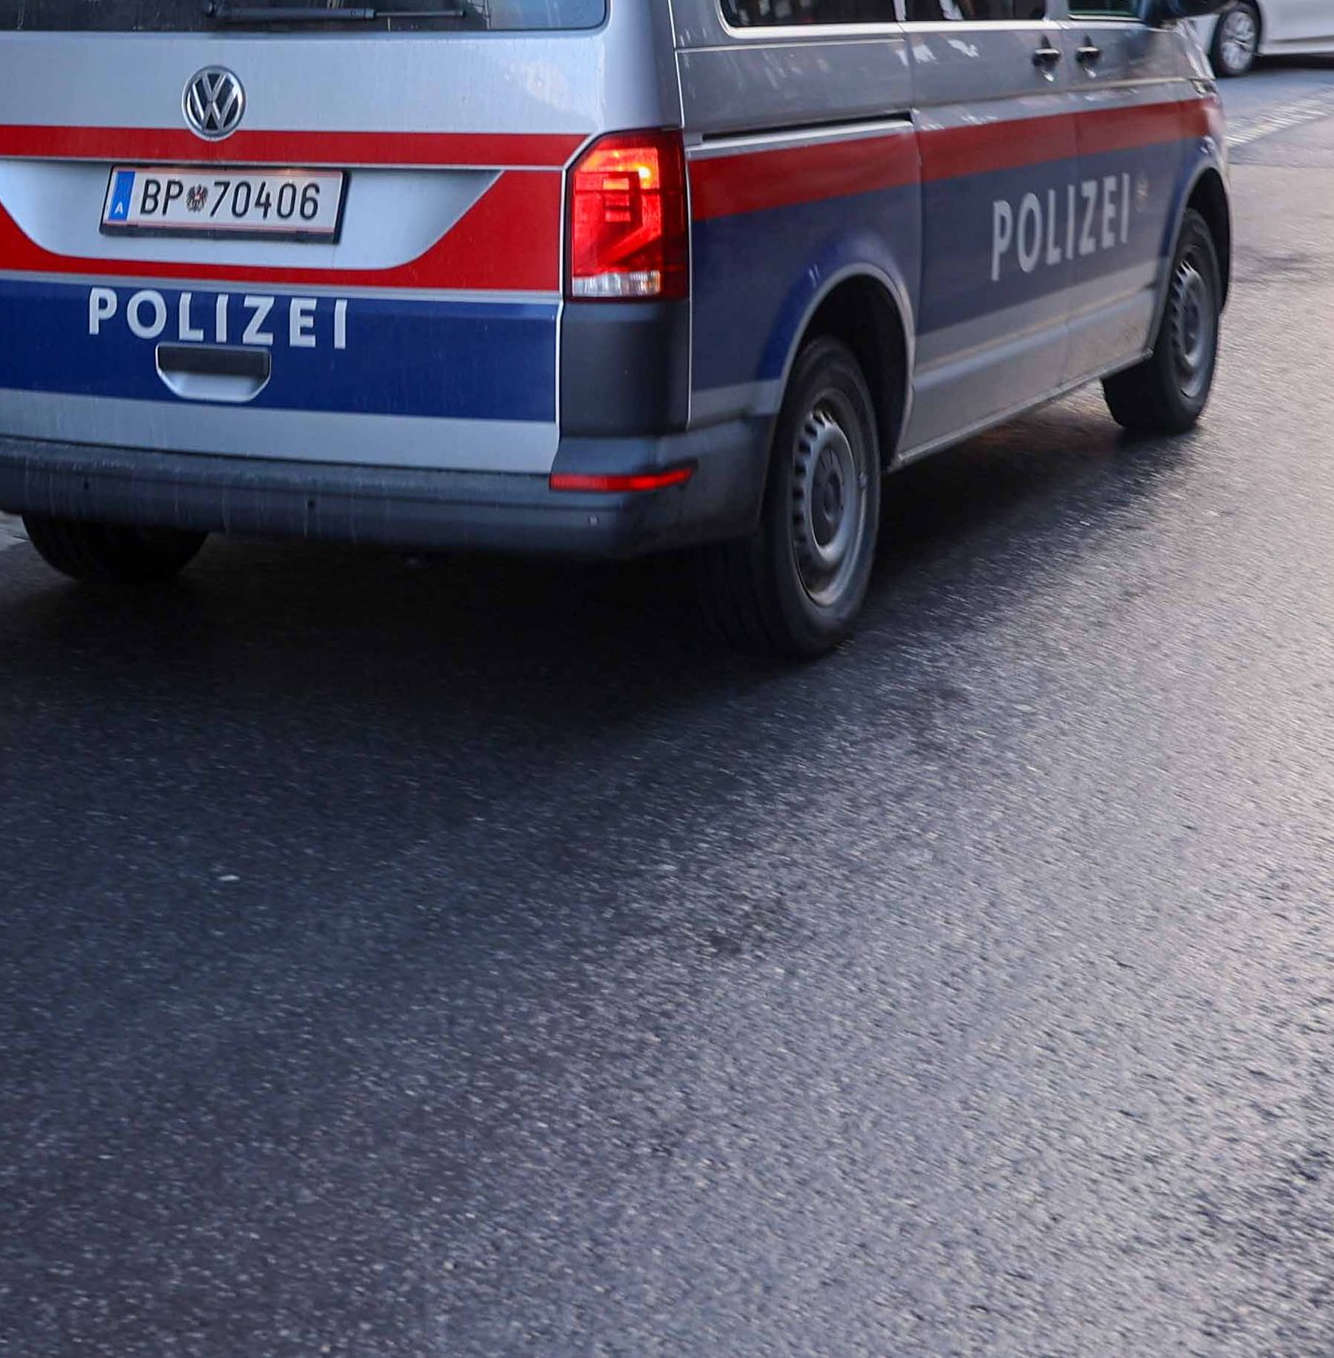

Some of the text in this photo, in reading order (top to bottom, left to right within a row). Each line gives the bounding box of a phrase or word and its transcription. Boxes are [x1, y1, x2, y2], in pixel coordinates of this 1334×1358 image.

[140, 179, 184, 215] BP
[210, 180, 321, 221] 70406
[990, 172, 1131, 283] POLIZEI
[88, 286, 348, 349] POLIZEI
